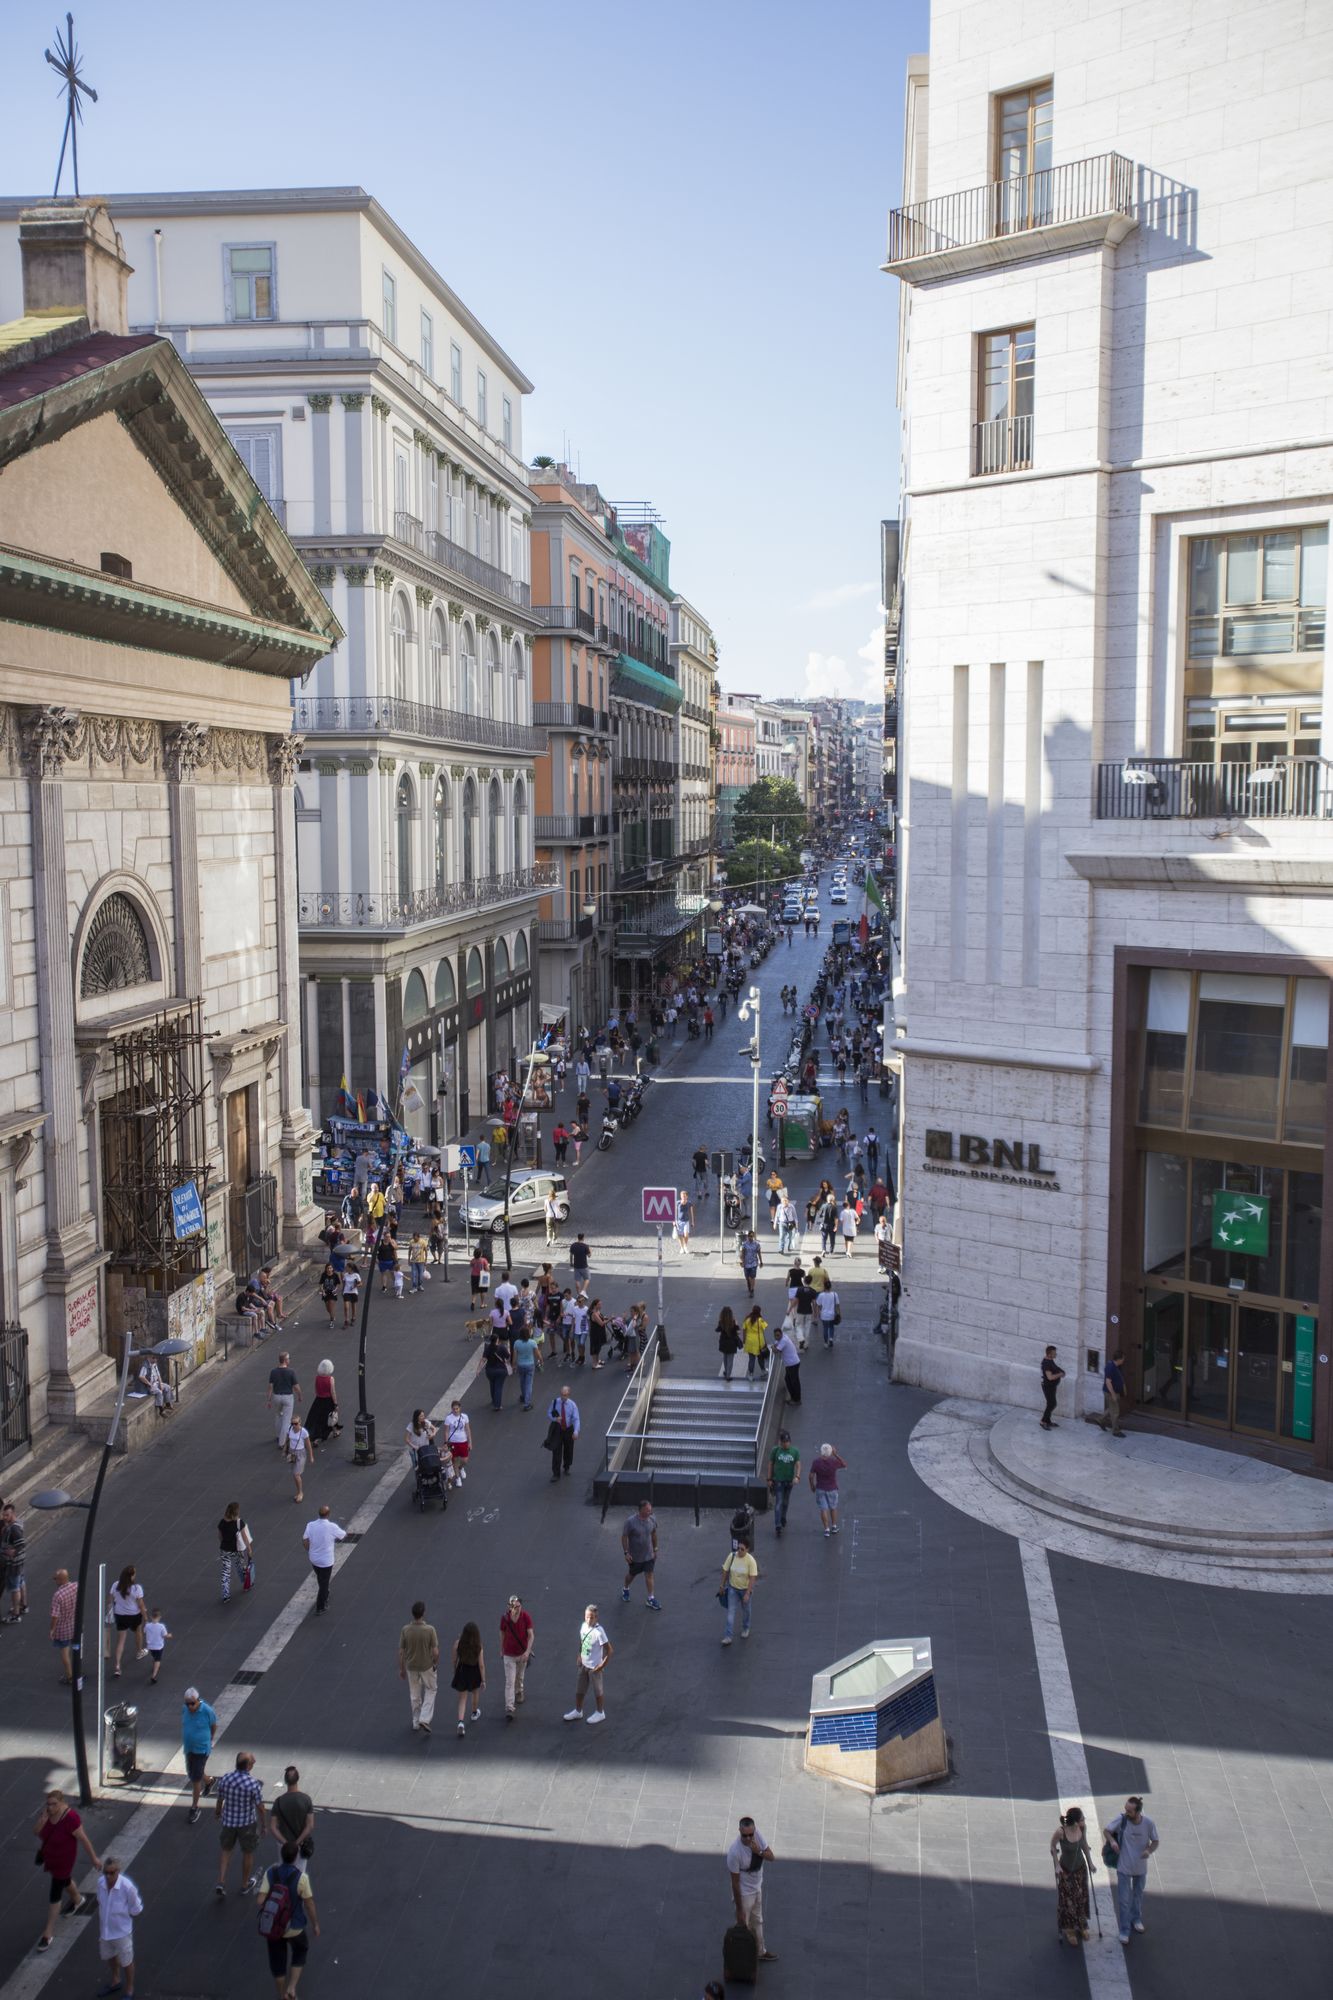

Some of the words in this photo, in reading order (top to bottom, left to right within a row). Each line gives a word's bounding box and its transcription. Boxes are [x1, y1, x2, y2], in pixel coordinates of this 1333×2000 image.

[775, 1104, 785, 1113] 30
[959, 1134, 1056, 1176] BNL
[922, 1163, 966, 1177] Gruppo
[971, 1170, 999, 1180] BNP
[1001, 1175, 1061, 1191] PARIBAS
[646, 1196, 673, 1216] M
